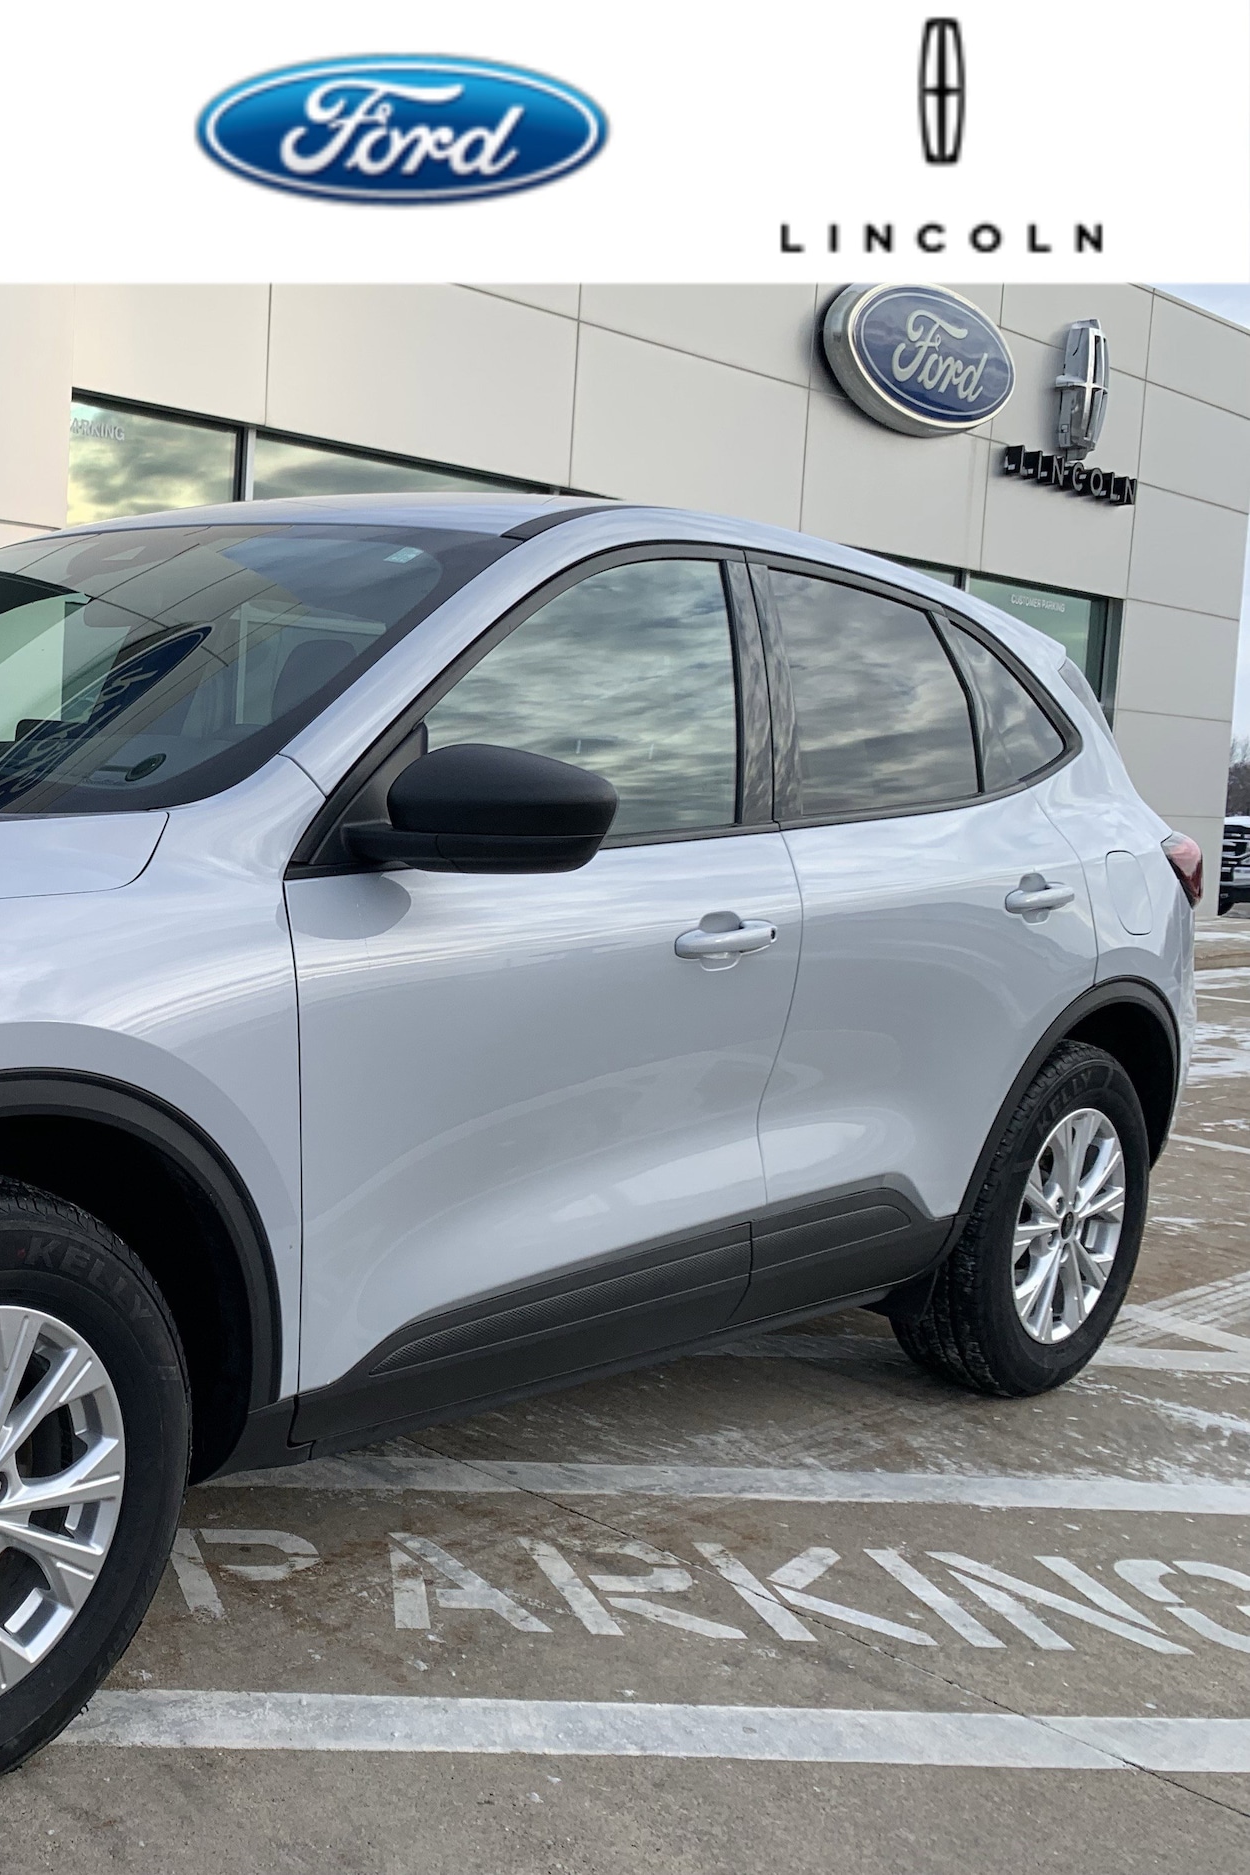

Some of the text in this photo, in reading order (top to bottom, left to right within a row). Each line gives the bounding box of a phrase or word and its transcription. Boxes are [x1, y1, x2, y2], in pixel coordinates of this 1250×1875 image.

[891, 308, 988, 403] Ford
[70, 417, 125, 441] ARKING
[1004, 445, 1138, 505] LINCOLN
[1011, 594, 1066, 613] CUSTOMER PARKING
[1036, 1069, 1092, 1139] KELLY
[24, 1236, 153, 1319] KELLY
[170, 1528, 1250, 1656] PARKING
